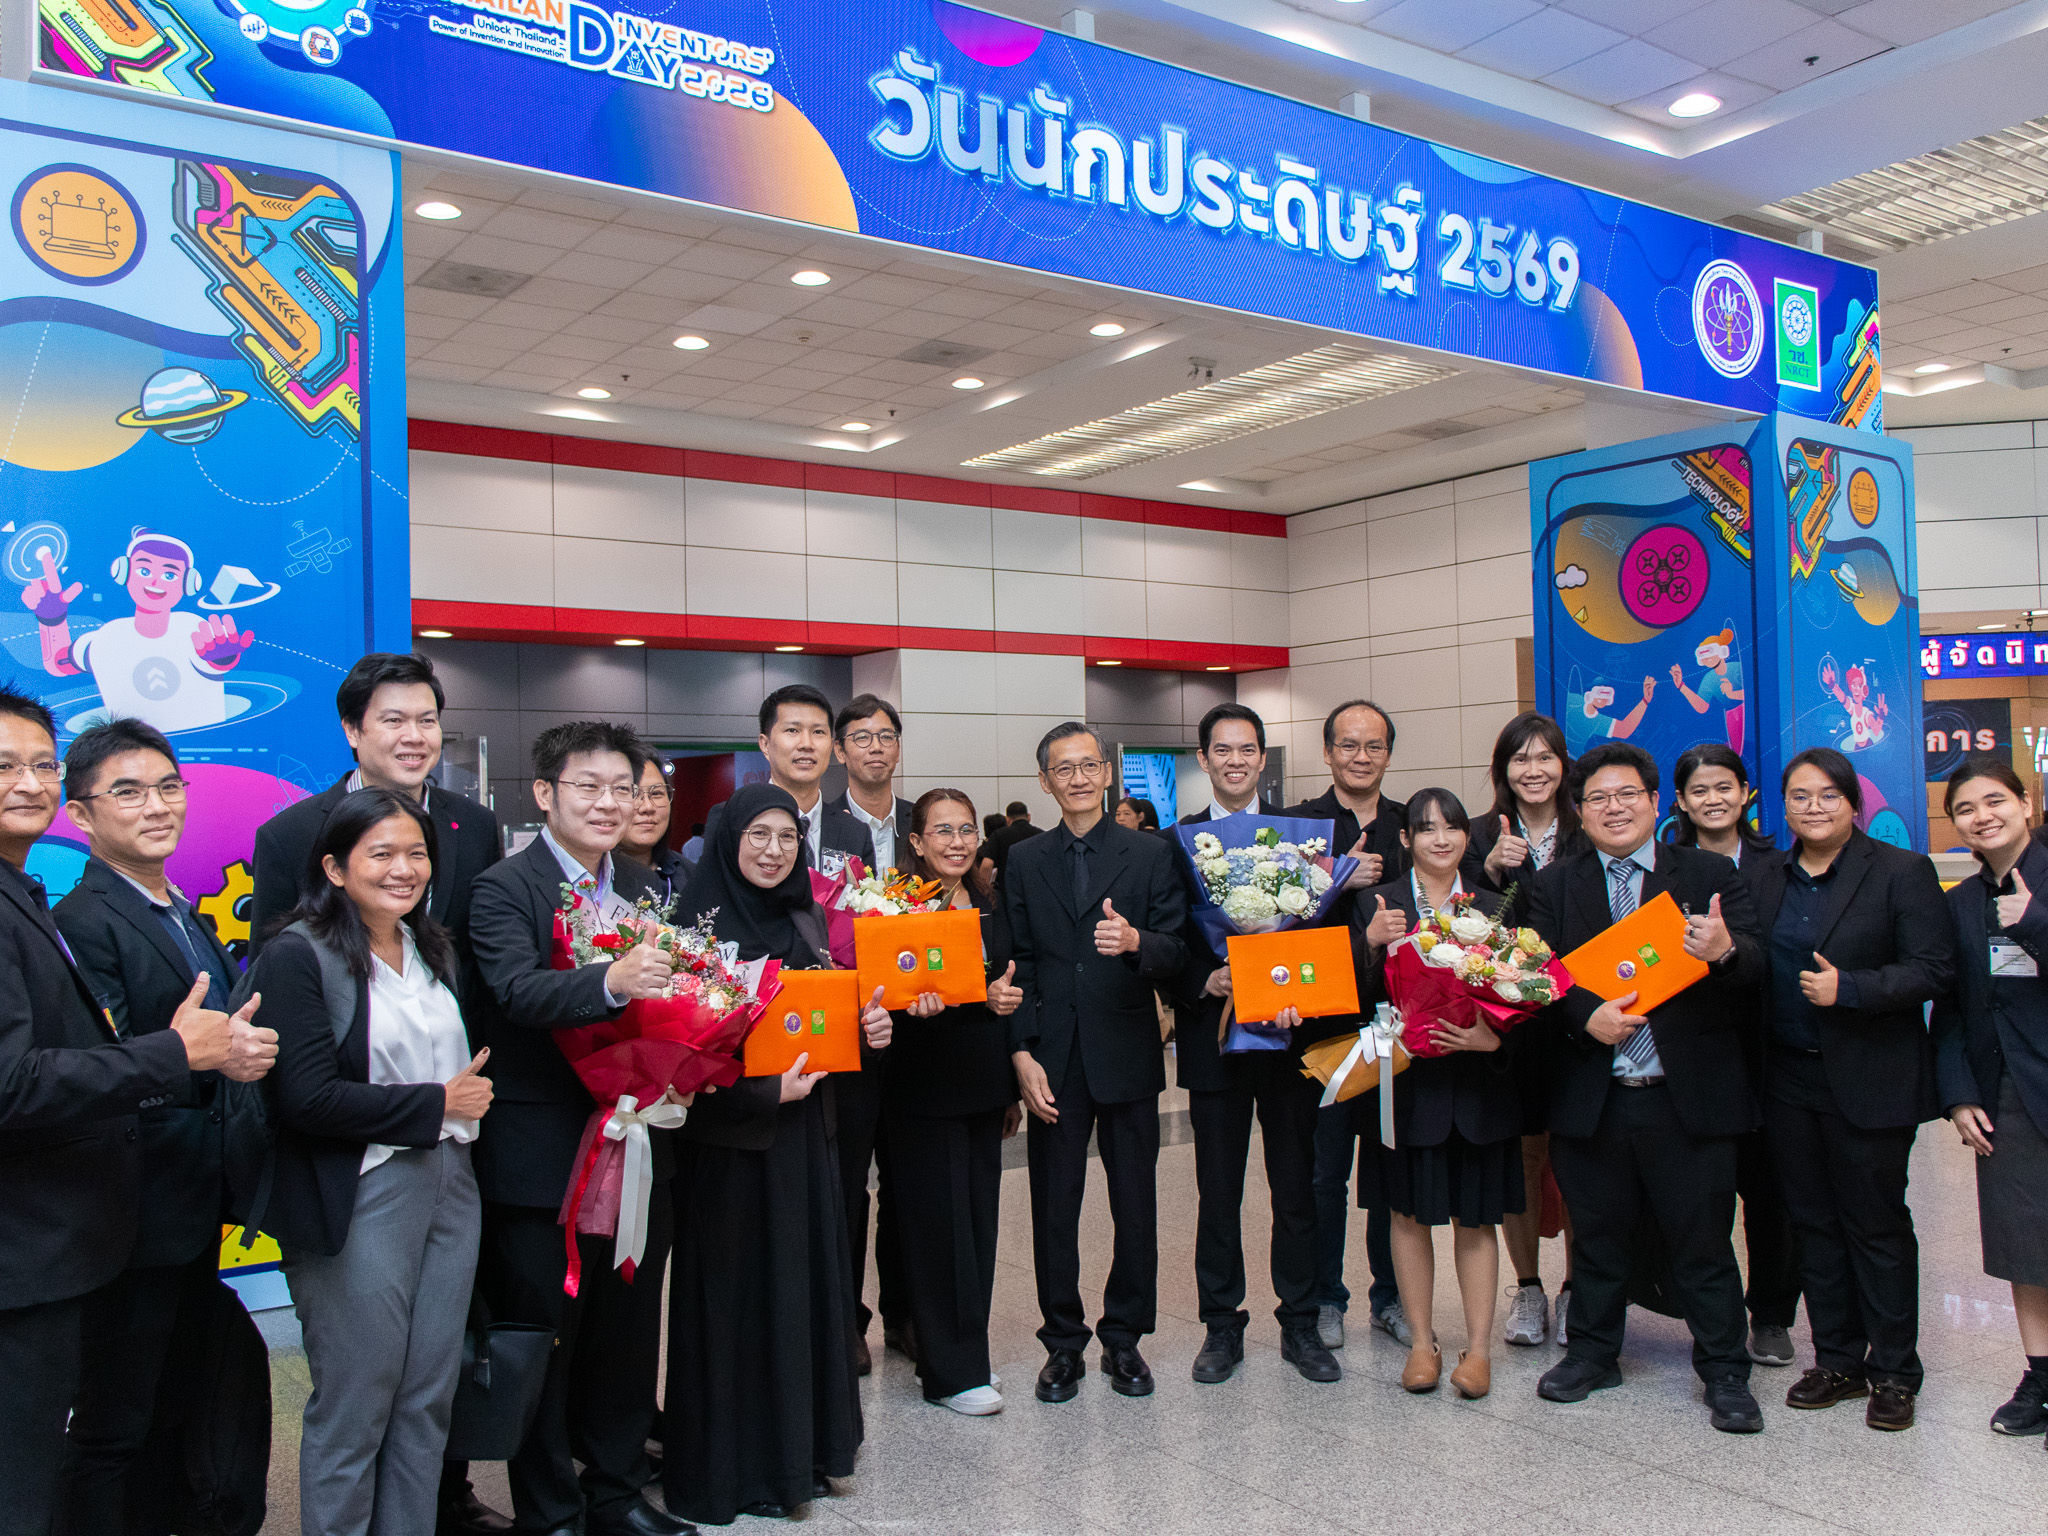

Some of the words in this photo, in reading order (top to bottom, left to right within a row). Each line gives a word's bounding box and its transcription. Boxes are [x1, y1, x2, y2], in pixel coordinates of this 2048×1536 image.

[432, 20, 457, 32] Power
[459, 27, 468, 35] of
[469, 29, 505, 44] Invention
[508, 39, 522, 48] and
[524, 41, 564, 59] Innovation
[477, 18, 511, 35] Unlock
[515, 27, 557, 46] Thailand
[685, 68, 769, 107] 2026
[873, 51, 1422, 296] วันนักประดิษฐ์
[1440, 212, 1580, 309] 2569
[1785, 364, 1810, 378] NRCT
[1788, 349, 1808, 365] วช.
[1682, 467, 1744, 524] TECHNOLOGY
[1926, 728, 1996, 752] การ
